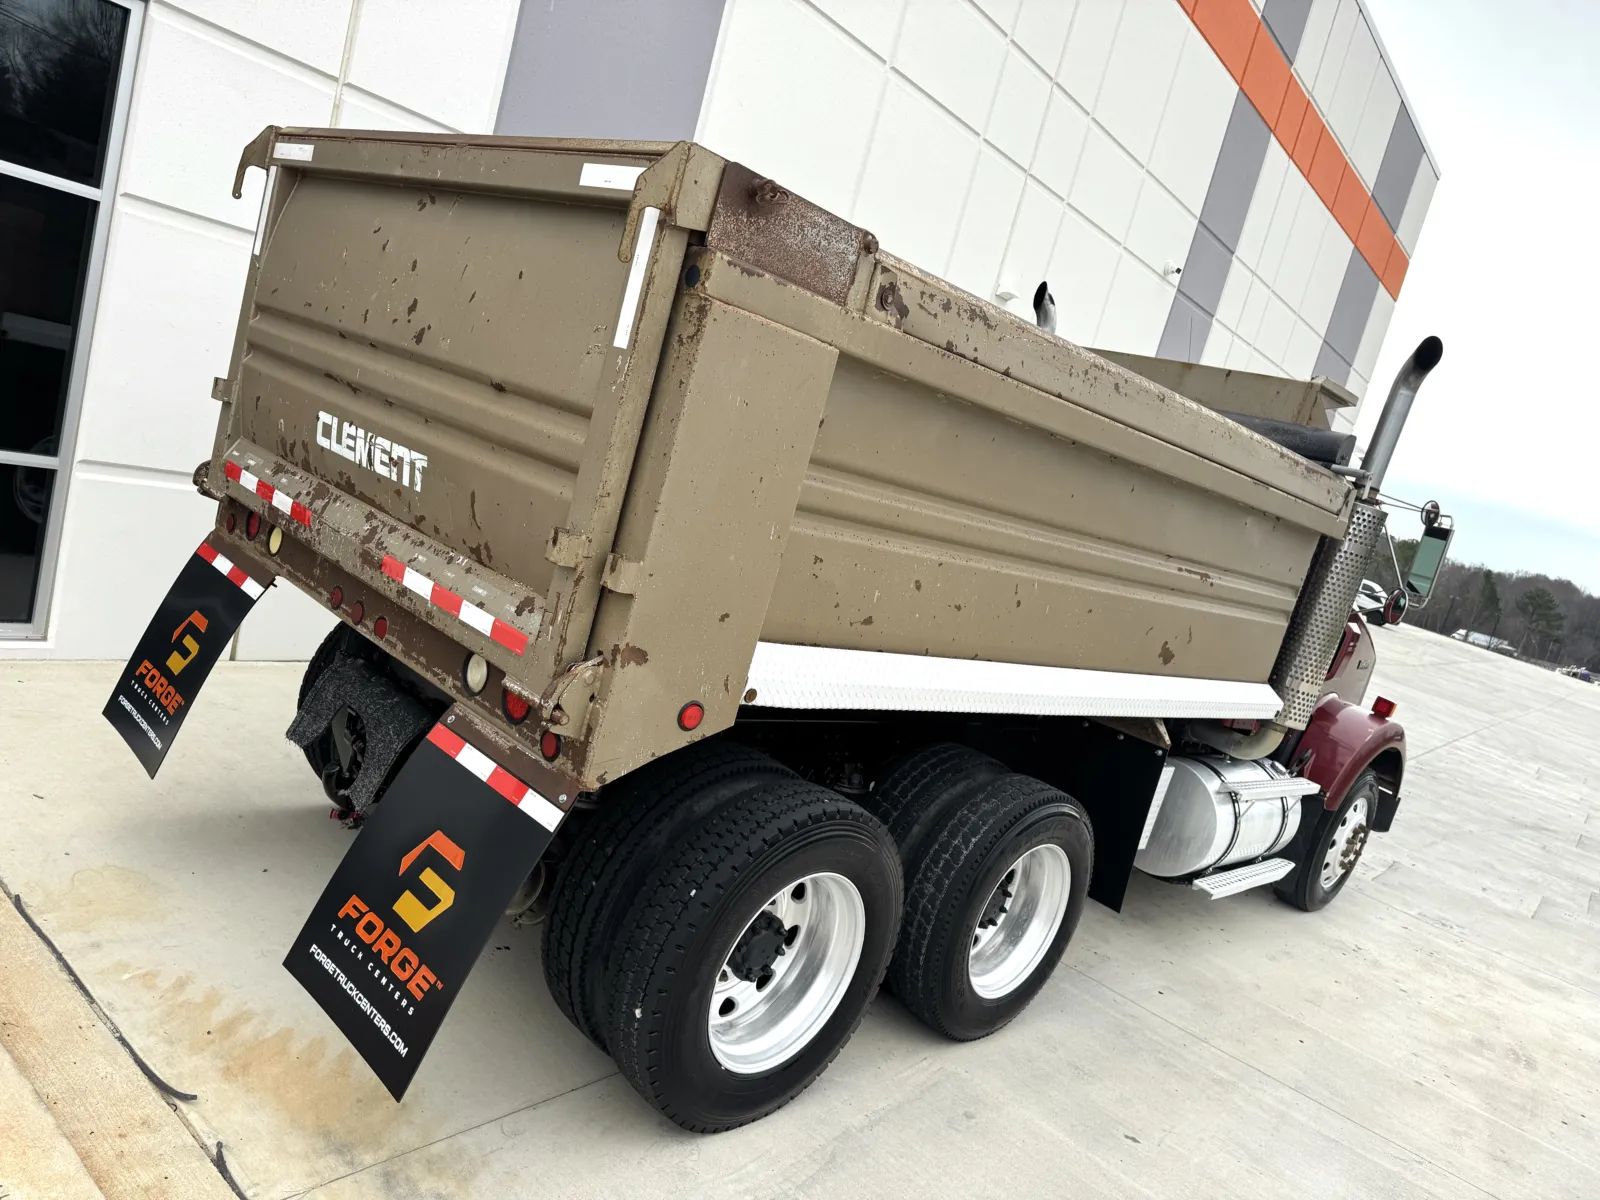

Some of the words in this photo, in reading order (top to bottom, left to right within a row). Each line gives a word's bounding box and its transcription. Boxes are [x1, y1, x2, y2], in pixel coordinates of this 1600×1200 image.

[316, 410, 428, 493] CLEMENT
[130, 680, 148, 700] TRUCK
[148, 699, 170, 726] CENTERS
[135, 659, 183, 716] FORGE
[330, 923, 364, 961] TRUCK
[367, 962, 415, 1016] CENTERS
[337, 894, 438, 1001] FORGE
[309, 943, 409, 1058] FORGETRUCKCENTERS.COM
